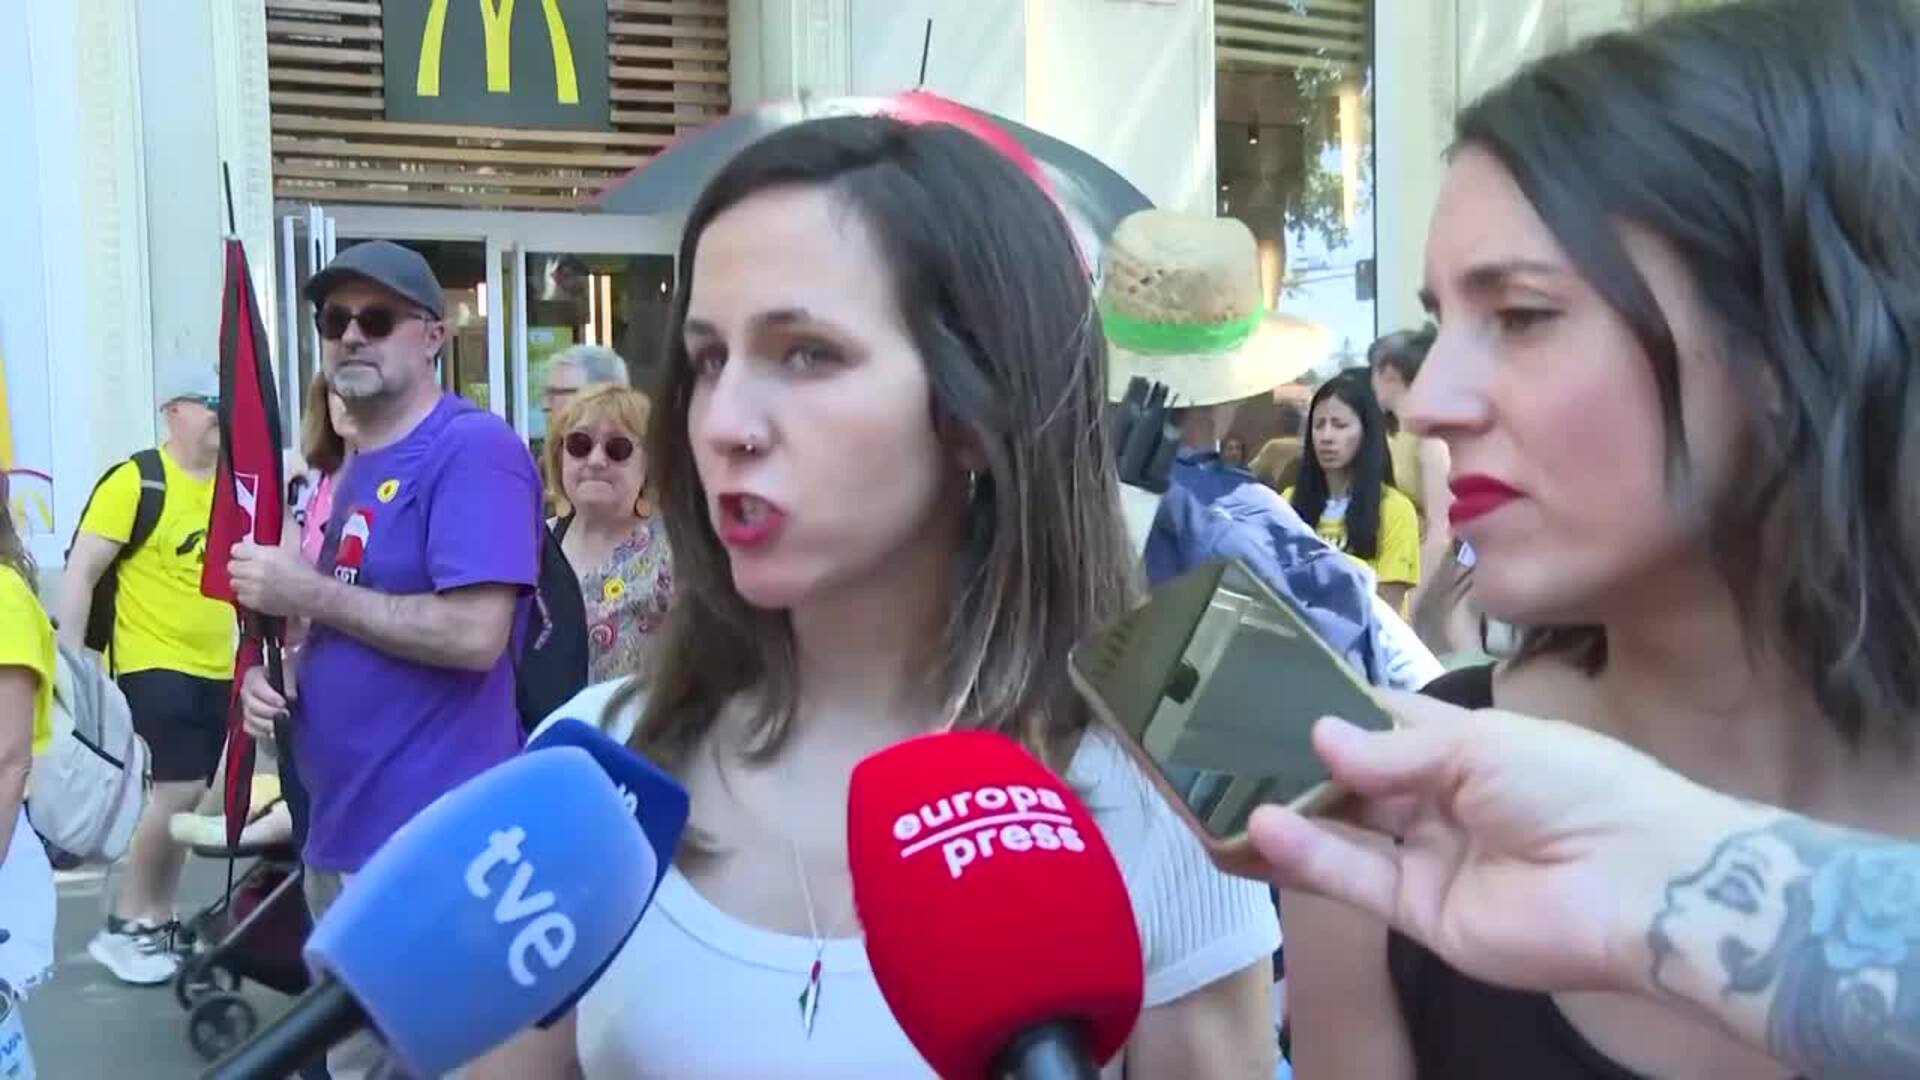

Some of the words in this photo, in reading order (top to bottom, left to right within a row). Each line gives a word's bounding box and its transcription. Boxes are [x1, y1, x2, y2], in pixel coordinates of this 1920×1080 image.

[334, 565, 358, 585] CGT
[893, 785, 1067, 840] europa
[942, 823, 1086, 879] press
[465, 826, 576, 987] tve
